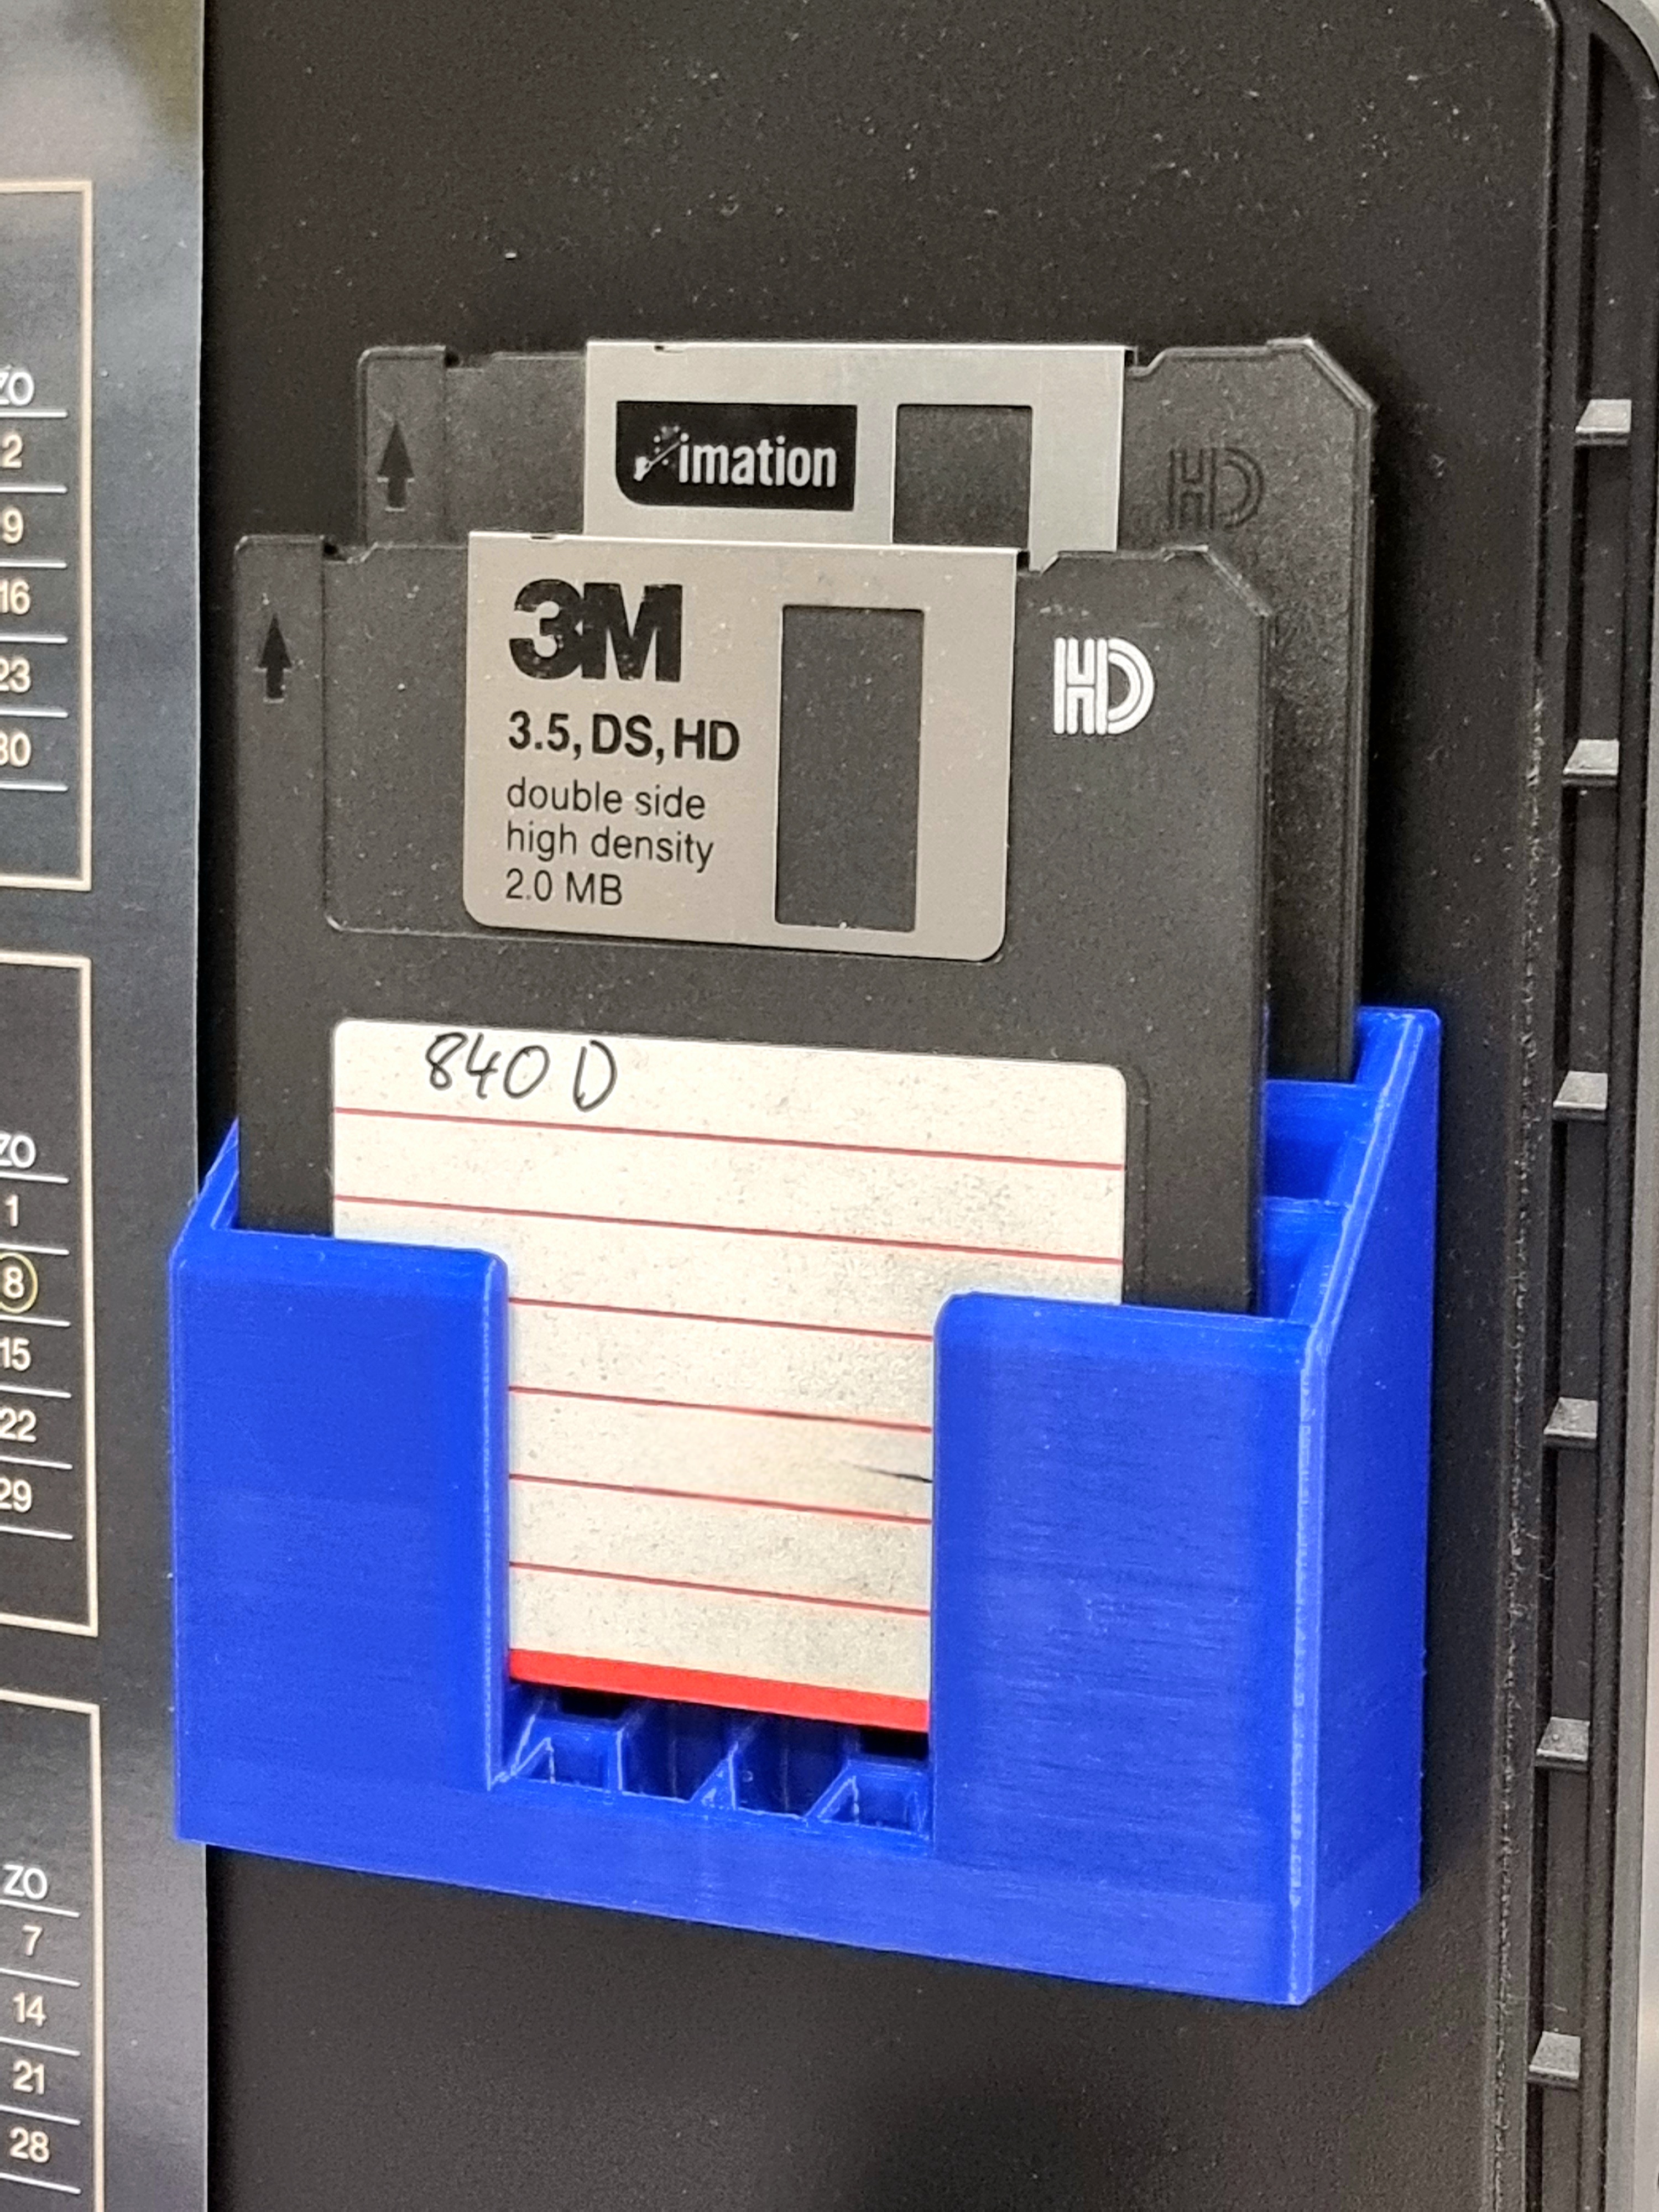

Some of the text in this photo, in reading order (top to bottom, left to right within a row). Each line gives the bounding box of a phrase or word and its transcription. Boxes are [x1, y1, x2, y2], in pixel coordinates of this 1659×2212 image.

[2, 434, 23, 469] 2
[679, 432, 837, 487] imation
[1168, 447, 1265, 530] HD
[2, 507, 24, 544] 9
[0, 580, 30, 615] 16
[509, 578, 683, 682] 3M
[1053, 637, 1155, 735] HD
[507, 776, 706, 820] double side
[507, 820, 714, 873] high density
[505, 868, 623, 906] 2.0 MB
[424, 1031, 551, 1100] 840
[5, 1194, 19, 1227] 1
[3, 1266, 24, 1299] 8
[0, 1337, 32, 1371] 15
[0, 1408, 37, 1443] 22
[0, 1477, 32, 1512] 29
[3, 1864, 48, 1900] ZO
[22, 1924, 43, 1957] 7
[12, 1992, 46, 2027] 14
[13, 2059, 45, 2095] 21
[9, 2126, 50, 2164] 28
